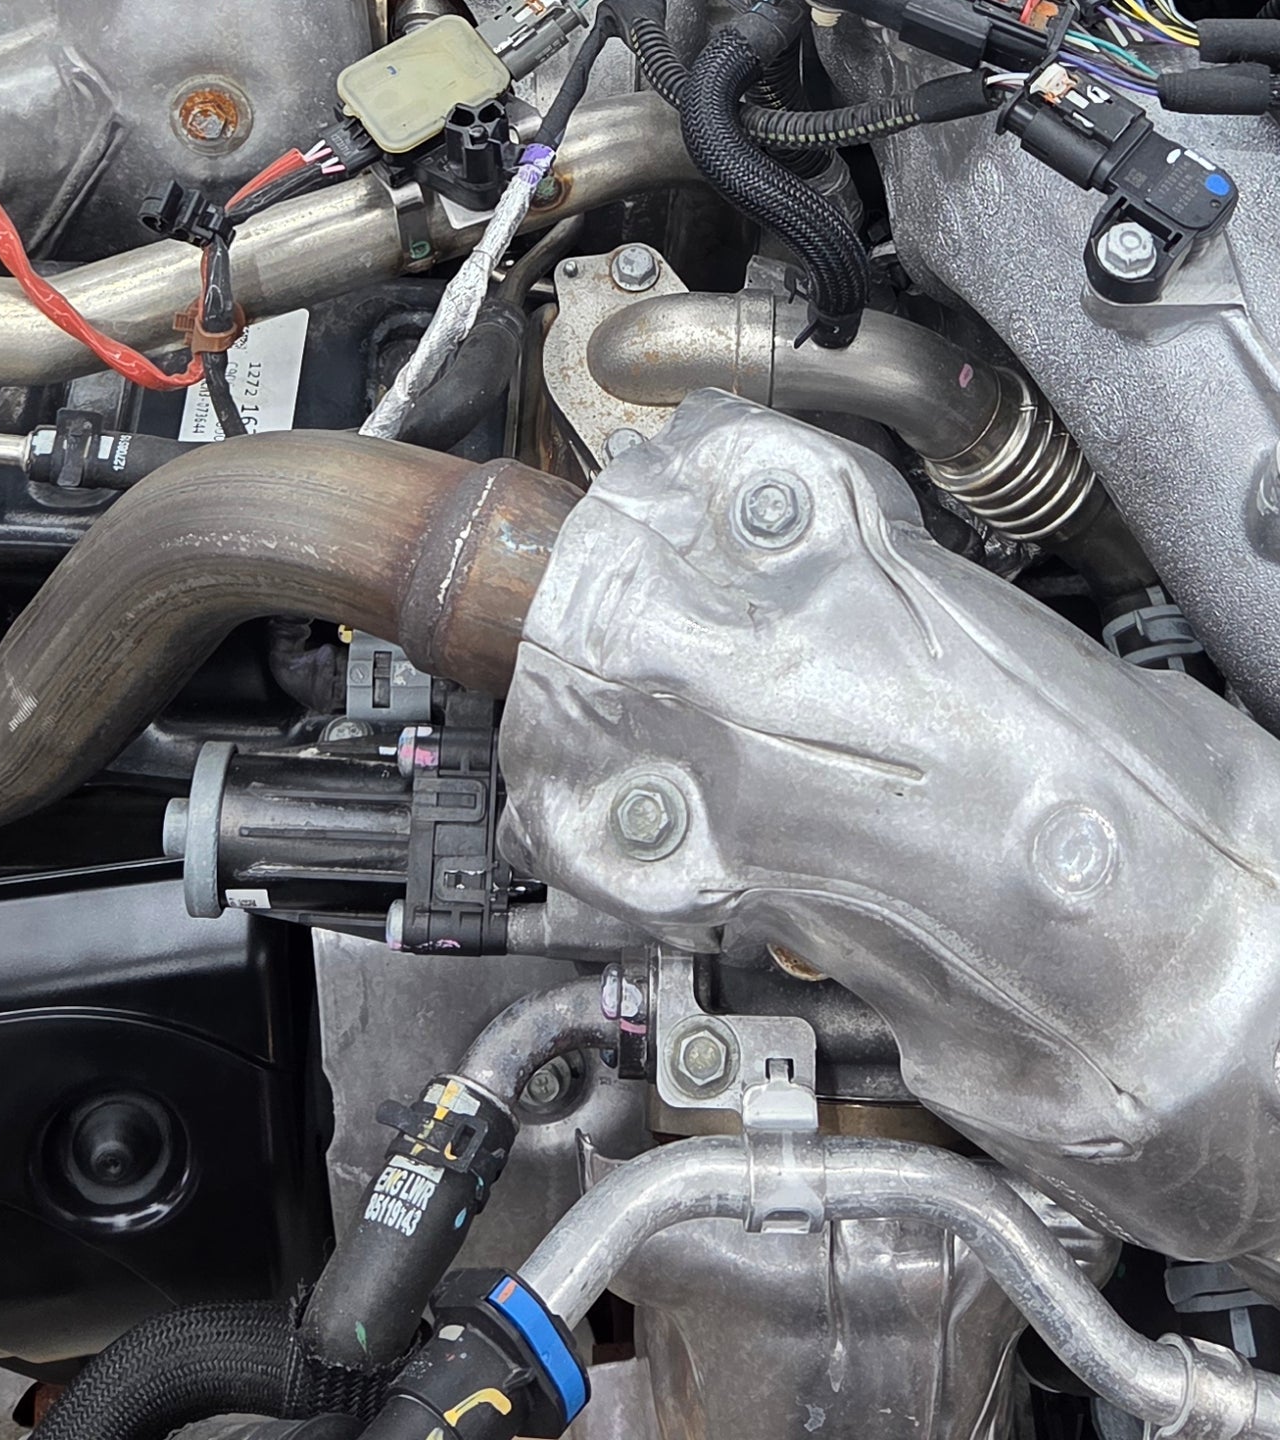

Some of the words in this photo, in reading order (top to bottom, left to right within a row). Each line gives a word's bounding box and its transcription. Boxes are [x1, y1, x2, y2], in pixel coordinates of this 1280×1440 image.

[244, 361, 261, 397] 1272
[374, 1166, 408, 1197] ENG
[400, 1173, 437, 1211] LWR
